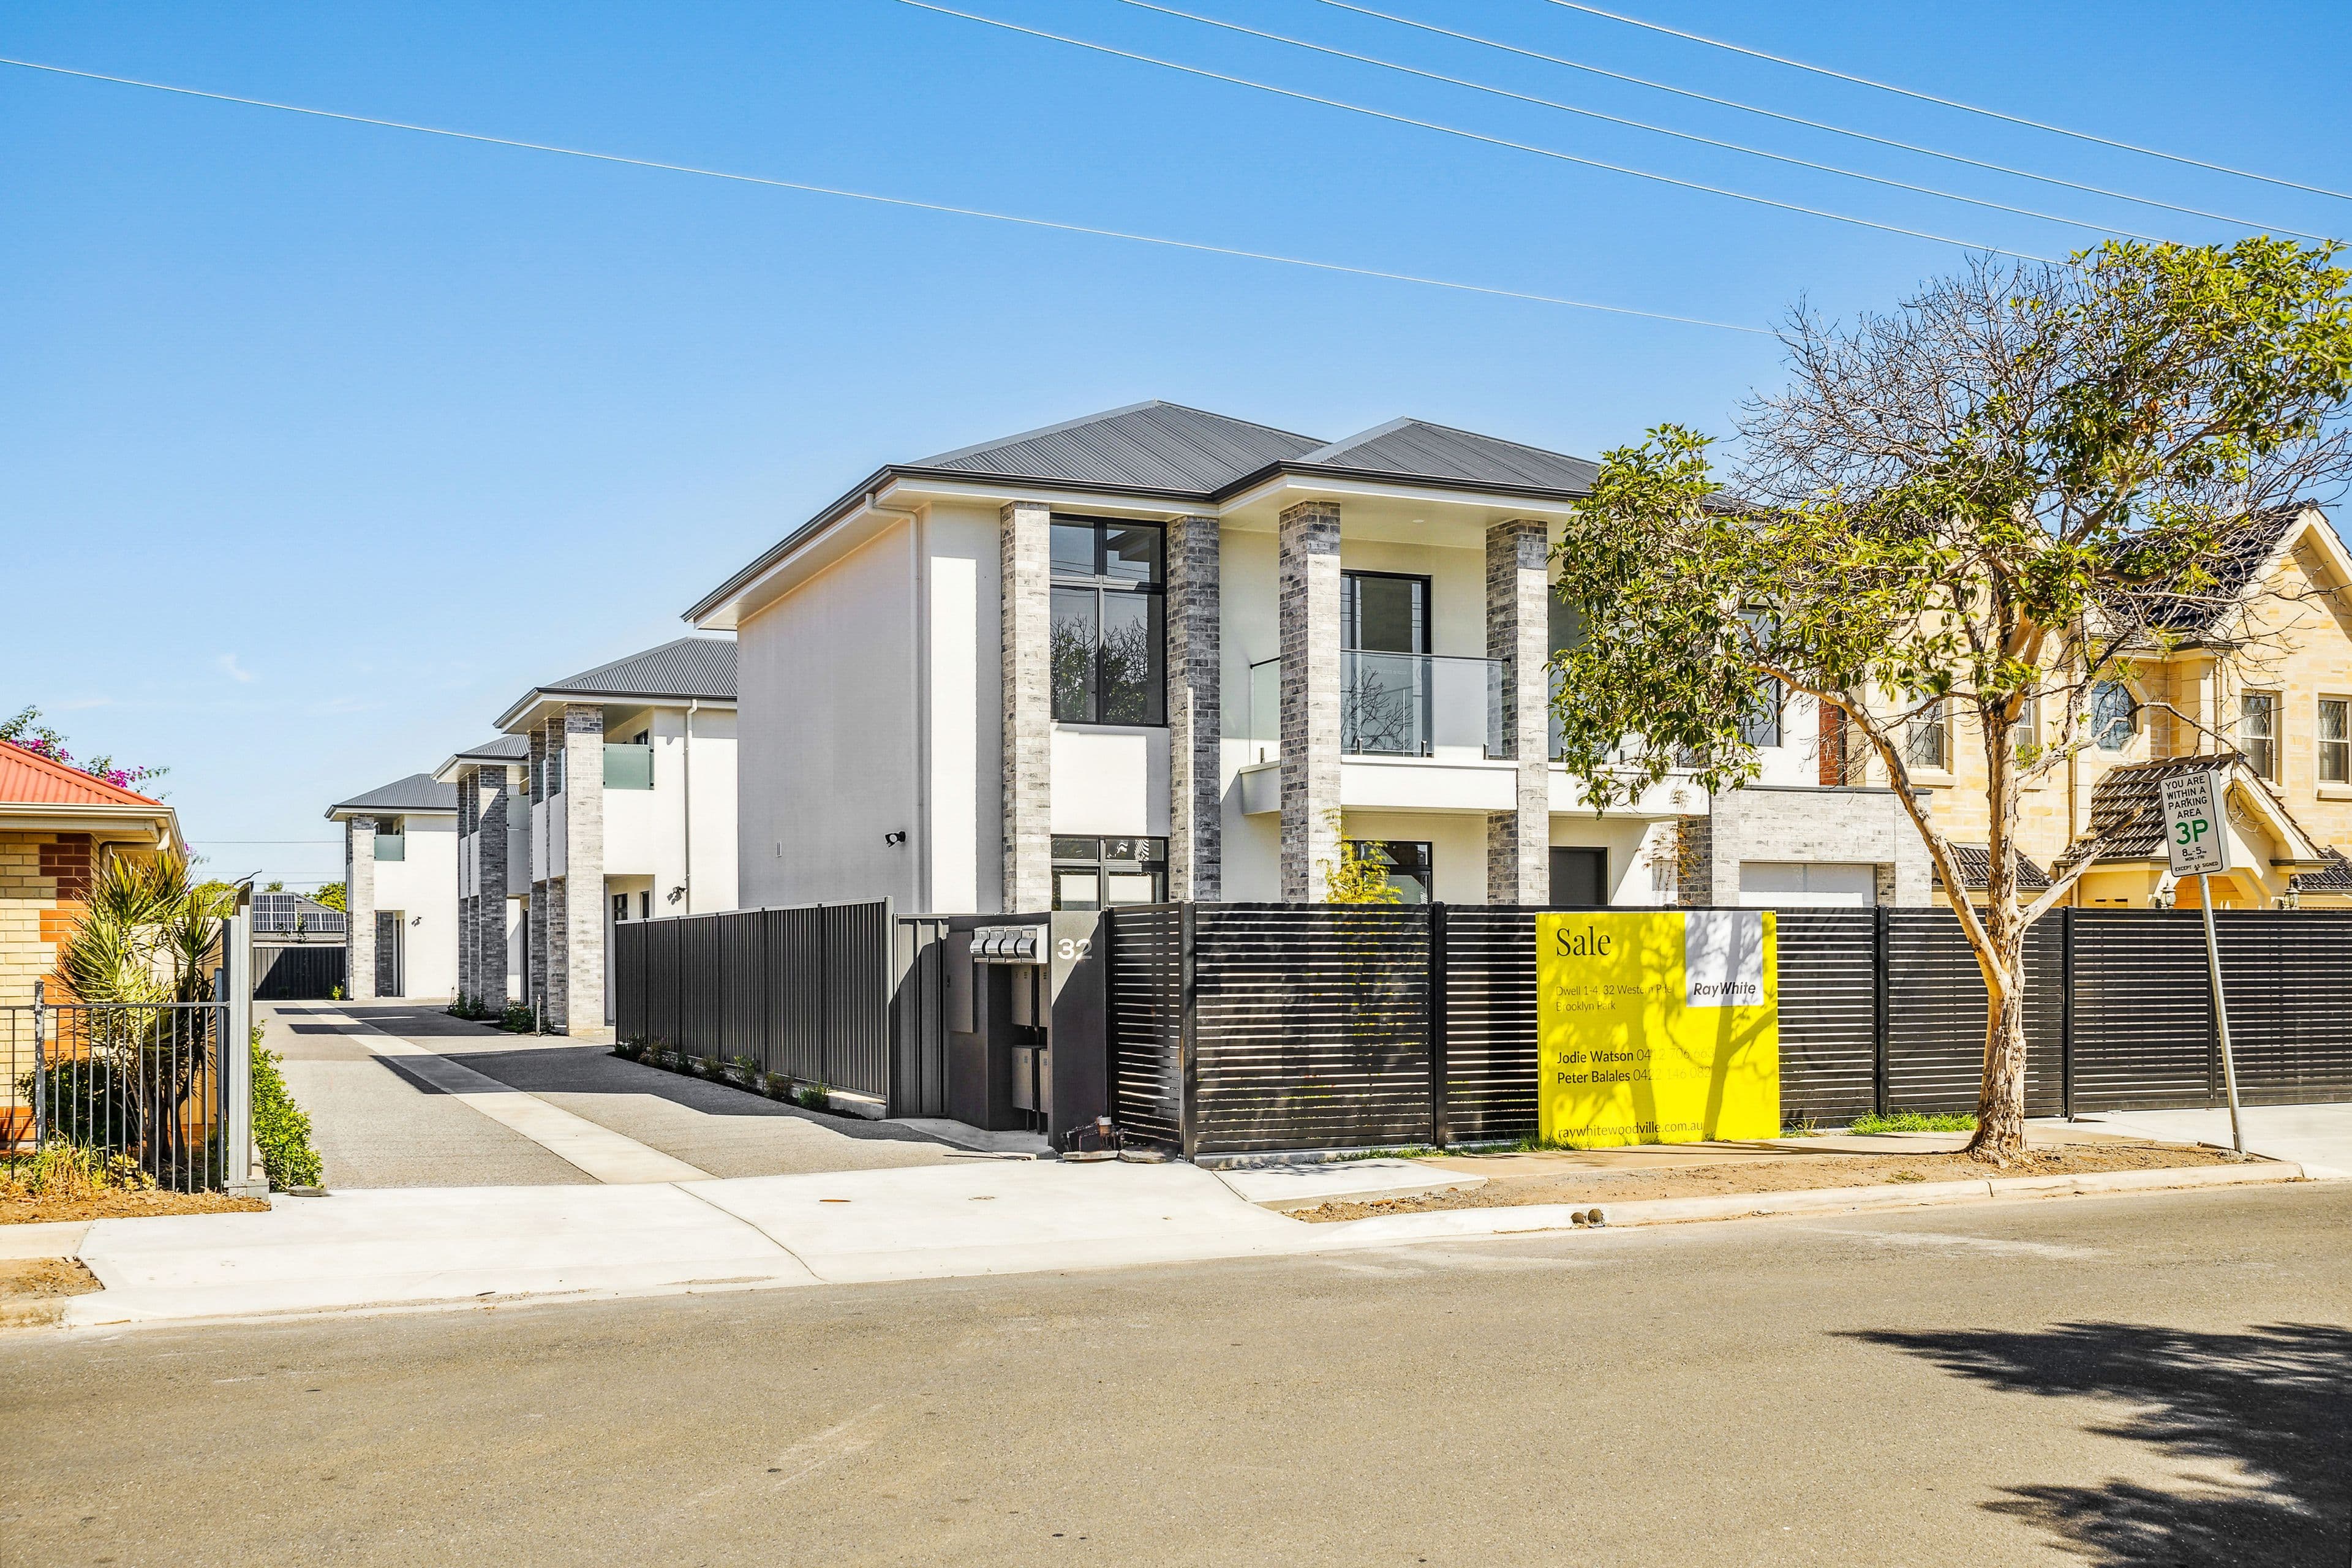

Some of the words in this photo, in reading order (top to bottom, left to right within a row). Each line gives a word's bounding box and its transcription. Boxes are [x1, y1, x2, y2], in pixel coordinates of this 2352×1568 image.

[2165, 779, 2184, 790] YOU
[2187, 775, 2205, 786] ARE
[2166, 788, 2196, 800] WITHIN
[2199, 786, 2206, 794] A
[2168, 796, 2207, 810] PARKING
[2177, 807, 2202, 819] AREA
[2174, 819, 2208, 845] 3P
[1556, 925, 1611, 957] Sale
[1057, 938, 1093, 960] 32
[1556, 986, 1580, 996] Dwell
[1603, 985, 1615, 995] 32
[1617, 984, 1654, 995] Westen
[1694, 981, 1756, 998] RayWhite
[1597, 1000, 1616, 1010] Park
[1557, 1051, 1587, 1064] Jodie
[1590, 1050, 1634, 1063] Watson
[1558, 1072, 1588, 1084] Peter
[1592, 1070, 1630, 1083] Balales
[1691, 1066, 1711, 1078] 082
[1558, 1121, 1703, 1139] raywhitewoodville.com.au
